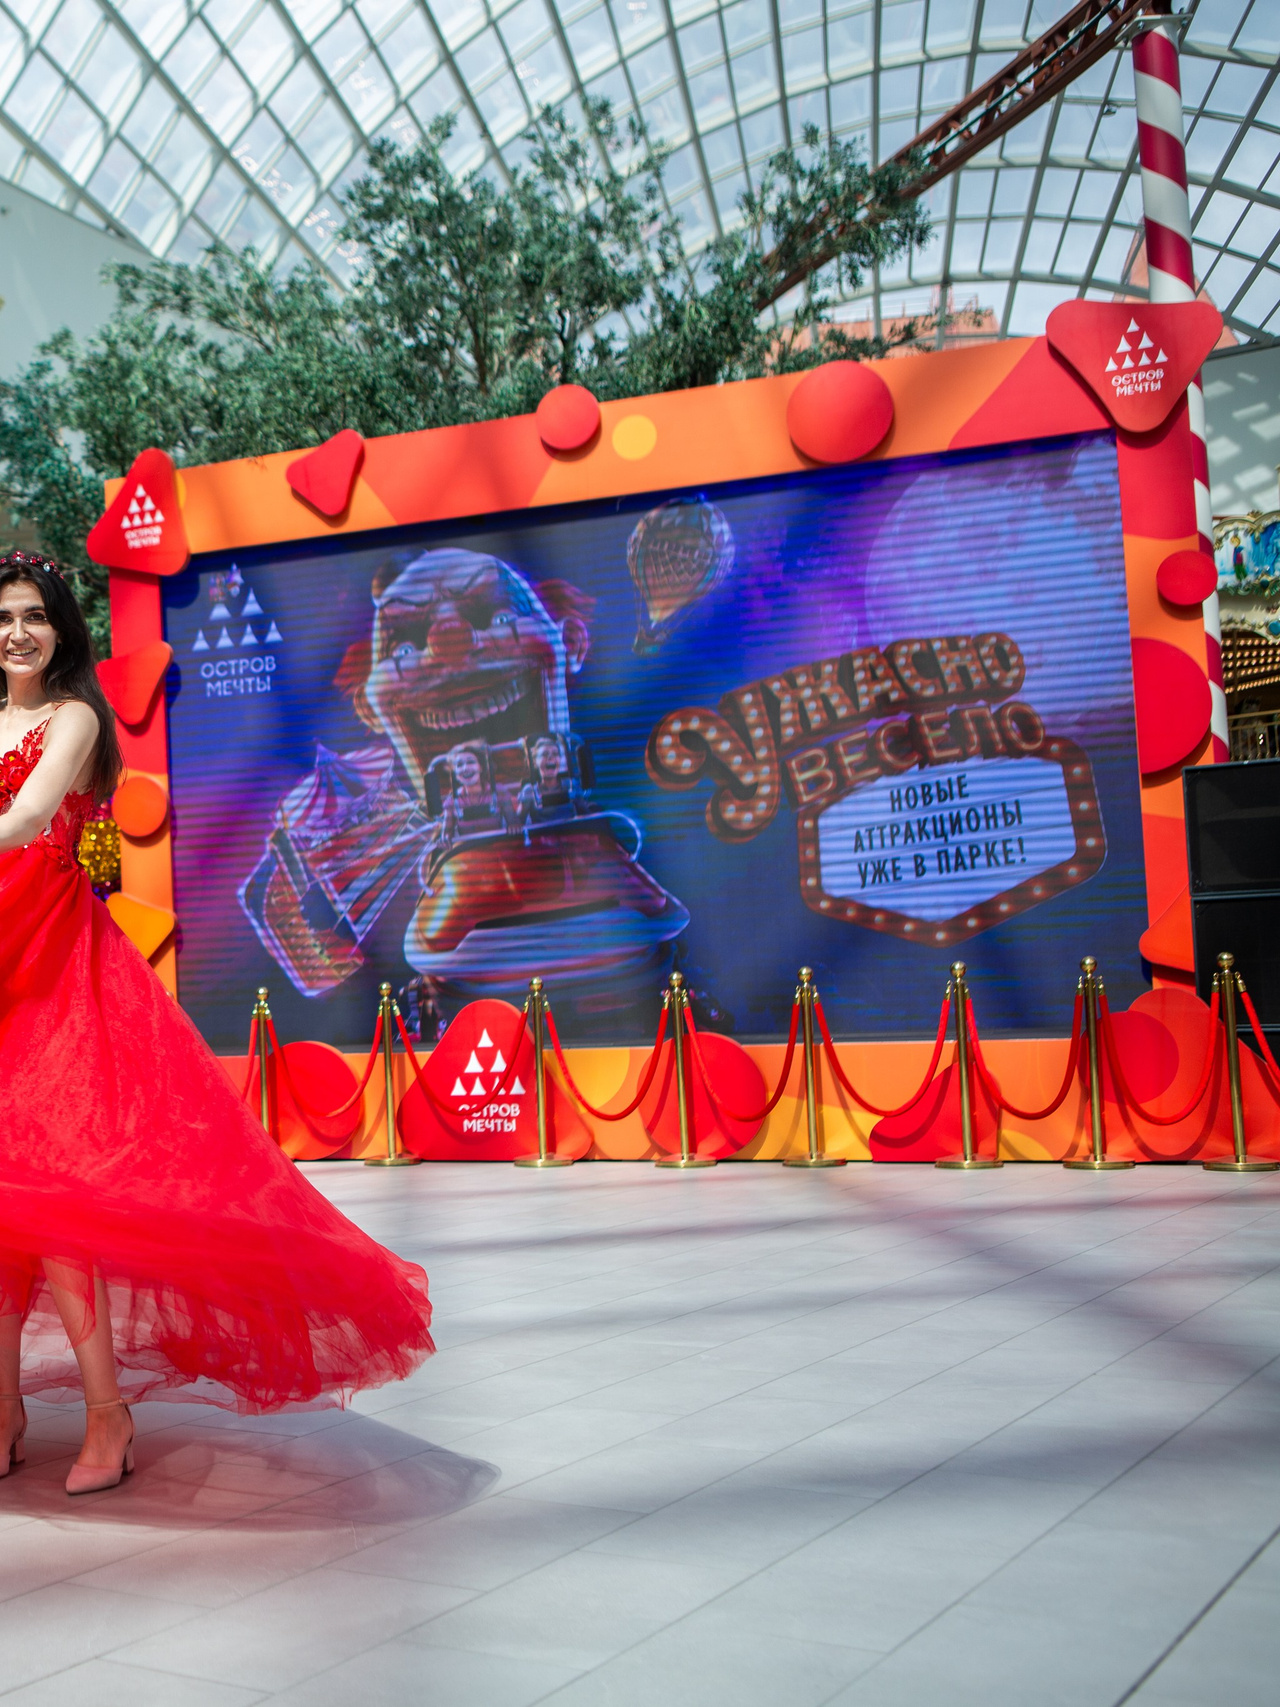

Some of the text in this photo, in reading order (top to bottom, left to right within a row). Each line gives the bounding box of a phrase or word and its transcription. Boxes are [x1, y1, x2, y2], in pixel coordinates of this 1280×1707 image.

[1111, 368, 1164, 387] ОСТРОВ
[1116, 380, 1161, 398] МЕЧТЫ
[200, 655, 277, 679] ОСТРОВ
[206, 675, 271, 698] МЕЧТЫ
[645, 632, 1026, 843] УЖАСНО
[787, 701, 1045, 808] ВЕСЕЛО
[889, 774, 969, 813] НОВЫЕ
[854, 799, 1023, 853] АТТРАКЦИОНЫ
[858, 837, 1027, 889] УЖЕ В ПАРКЕ!
[462, 1118, 517, 1133] МЕЧТЫ
